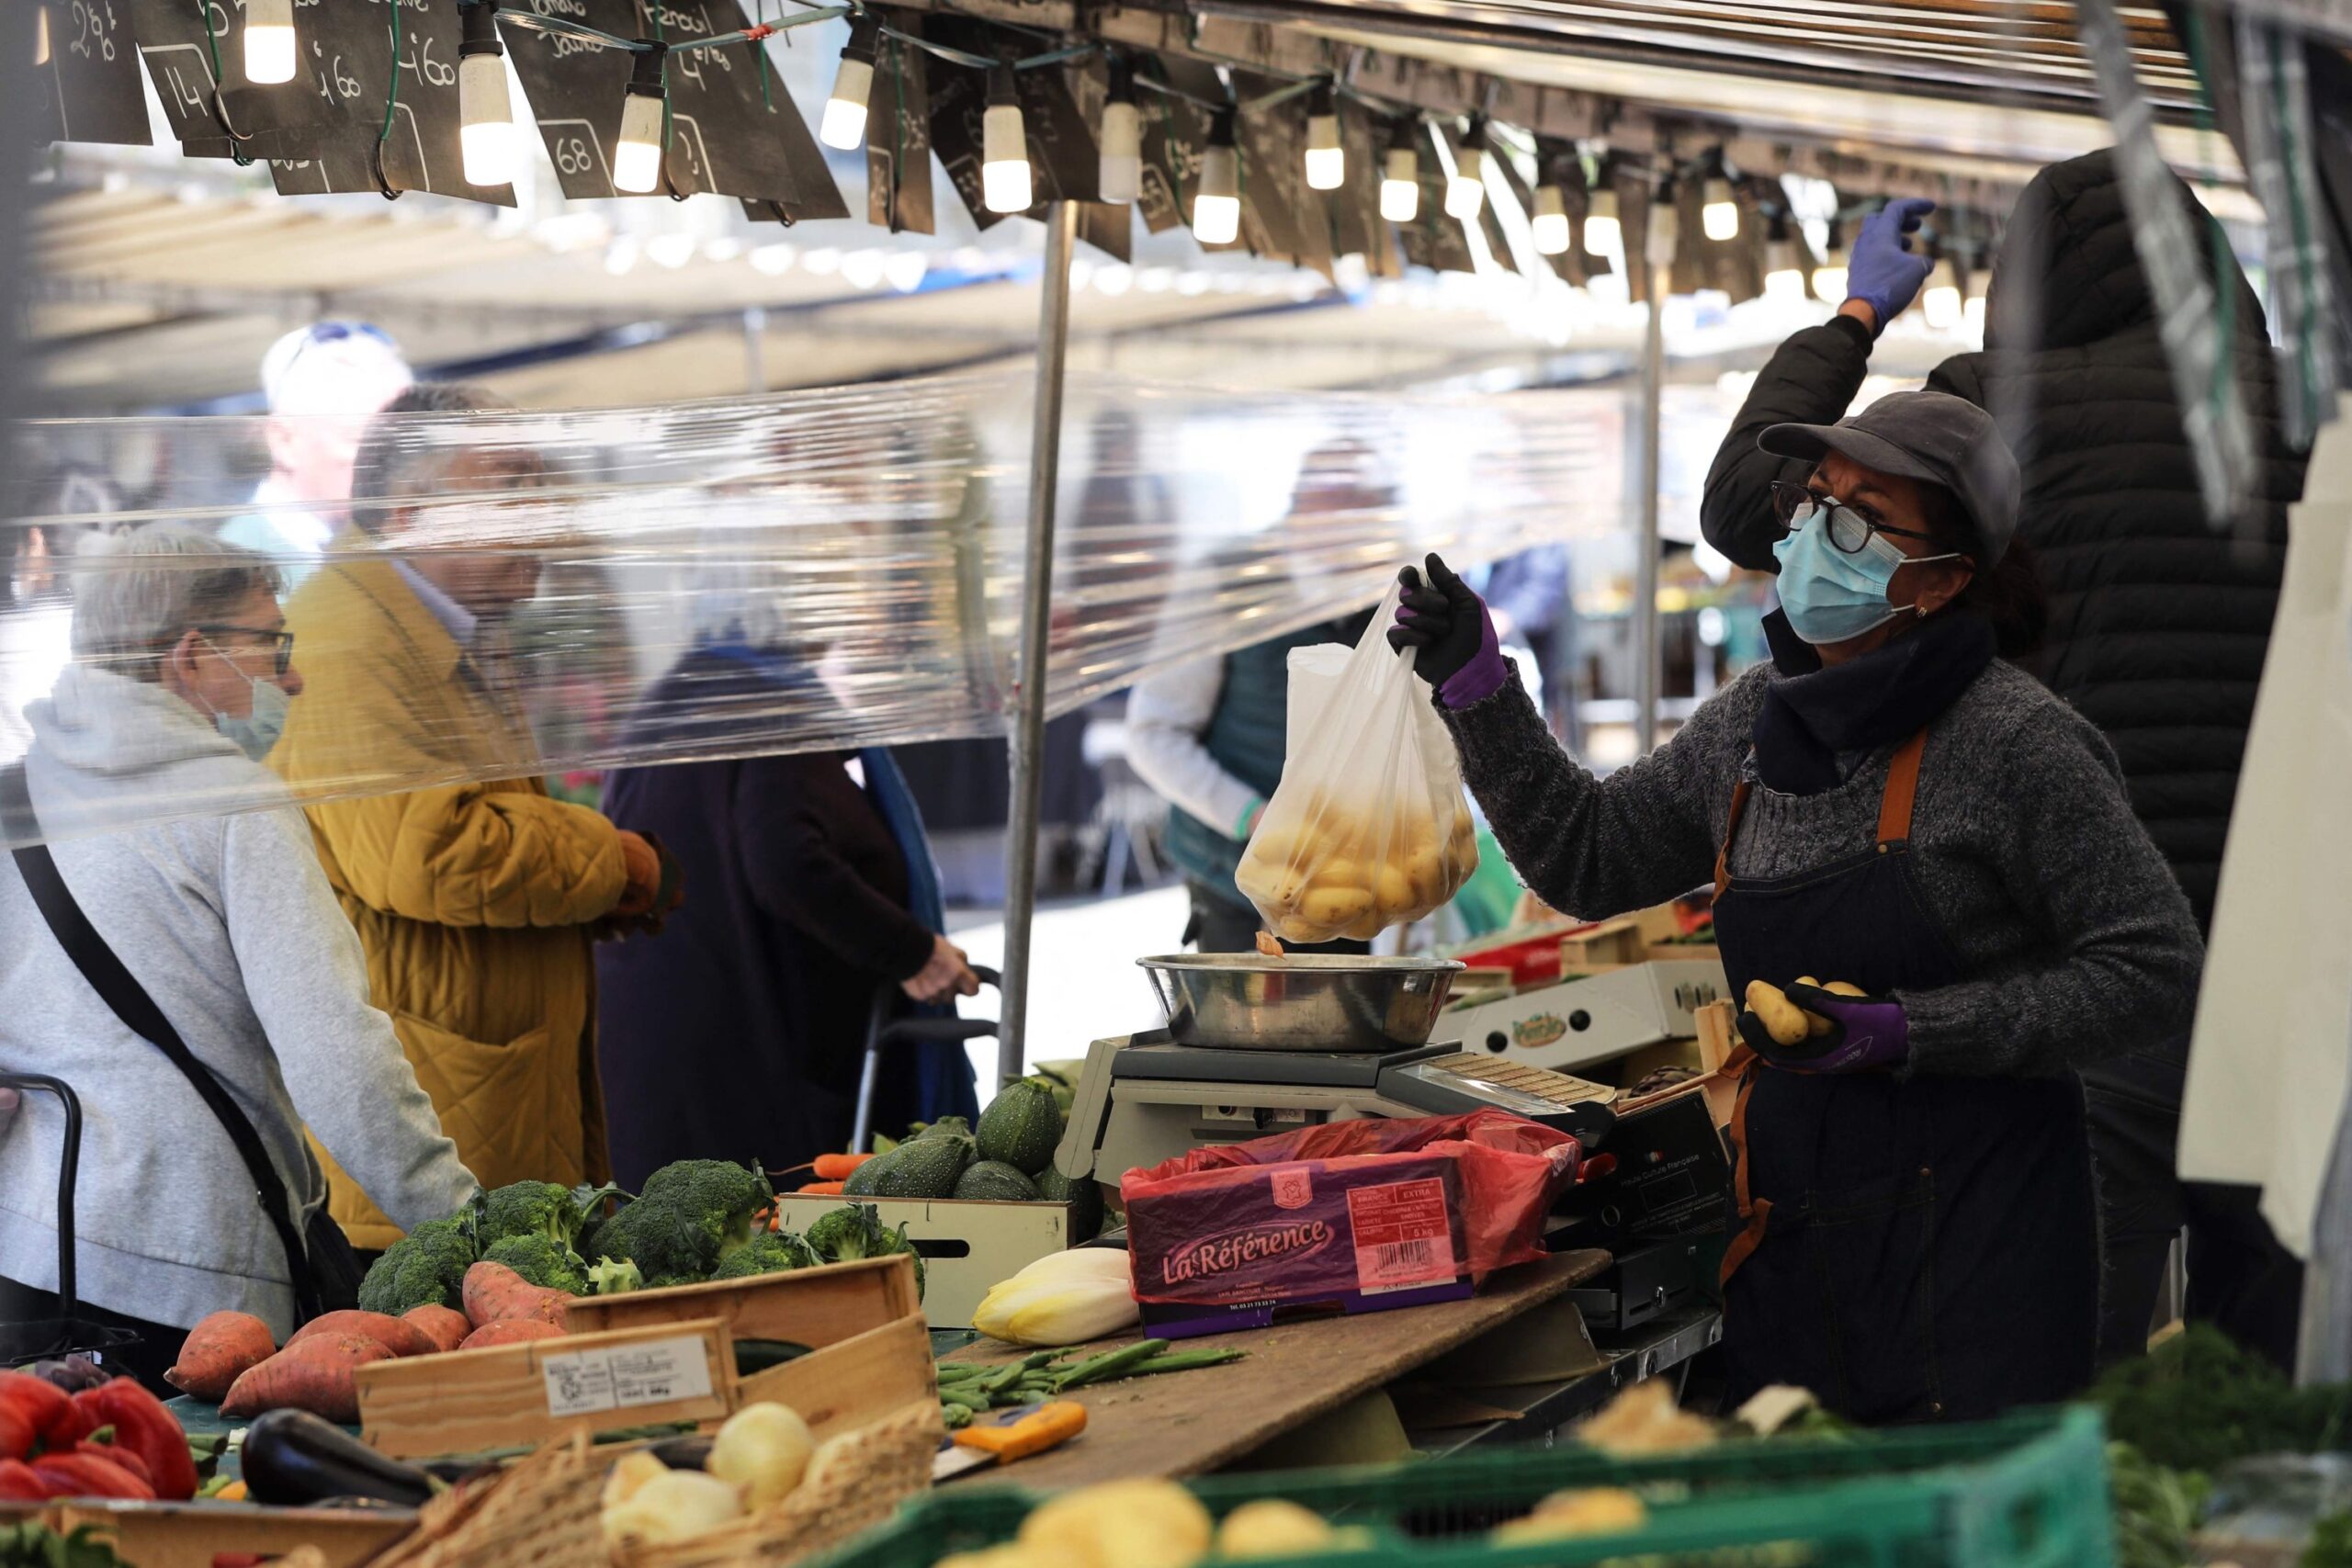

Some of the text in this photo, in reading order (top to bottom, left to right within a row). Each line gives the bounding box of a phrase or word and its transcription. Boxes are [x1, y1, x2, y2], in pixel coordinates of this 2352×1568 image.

[164, 66, 209, 119] 14
[556, 138, 592, 175] 68
[1403, 1188, 1431, 1199] EXTRA
[1421, 1227, 1434, 1238] kg
[1162, 1220, 1327, 1285] La Référence
